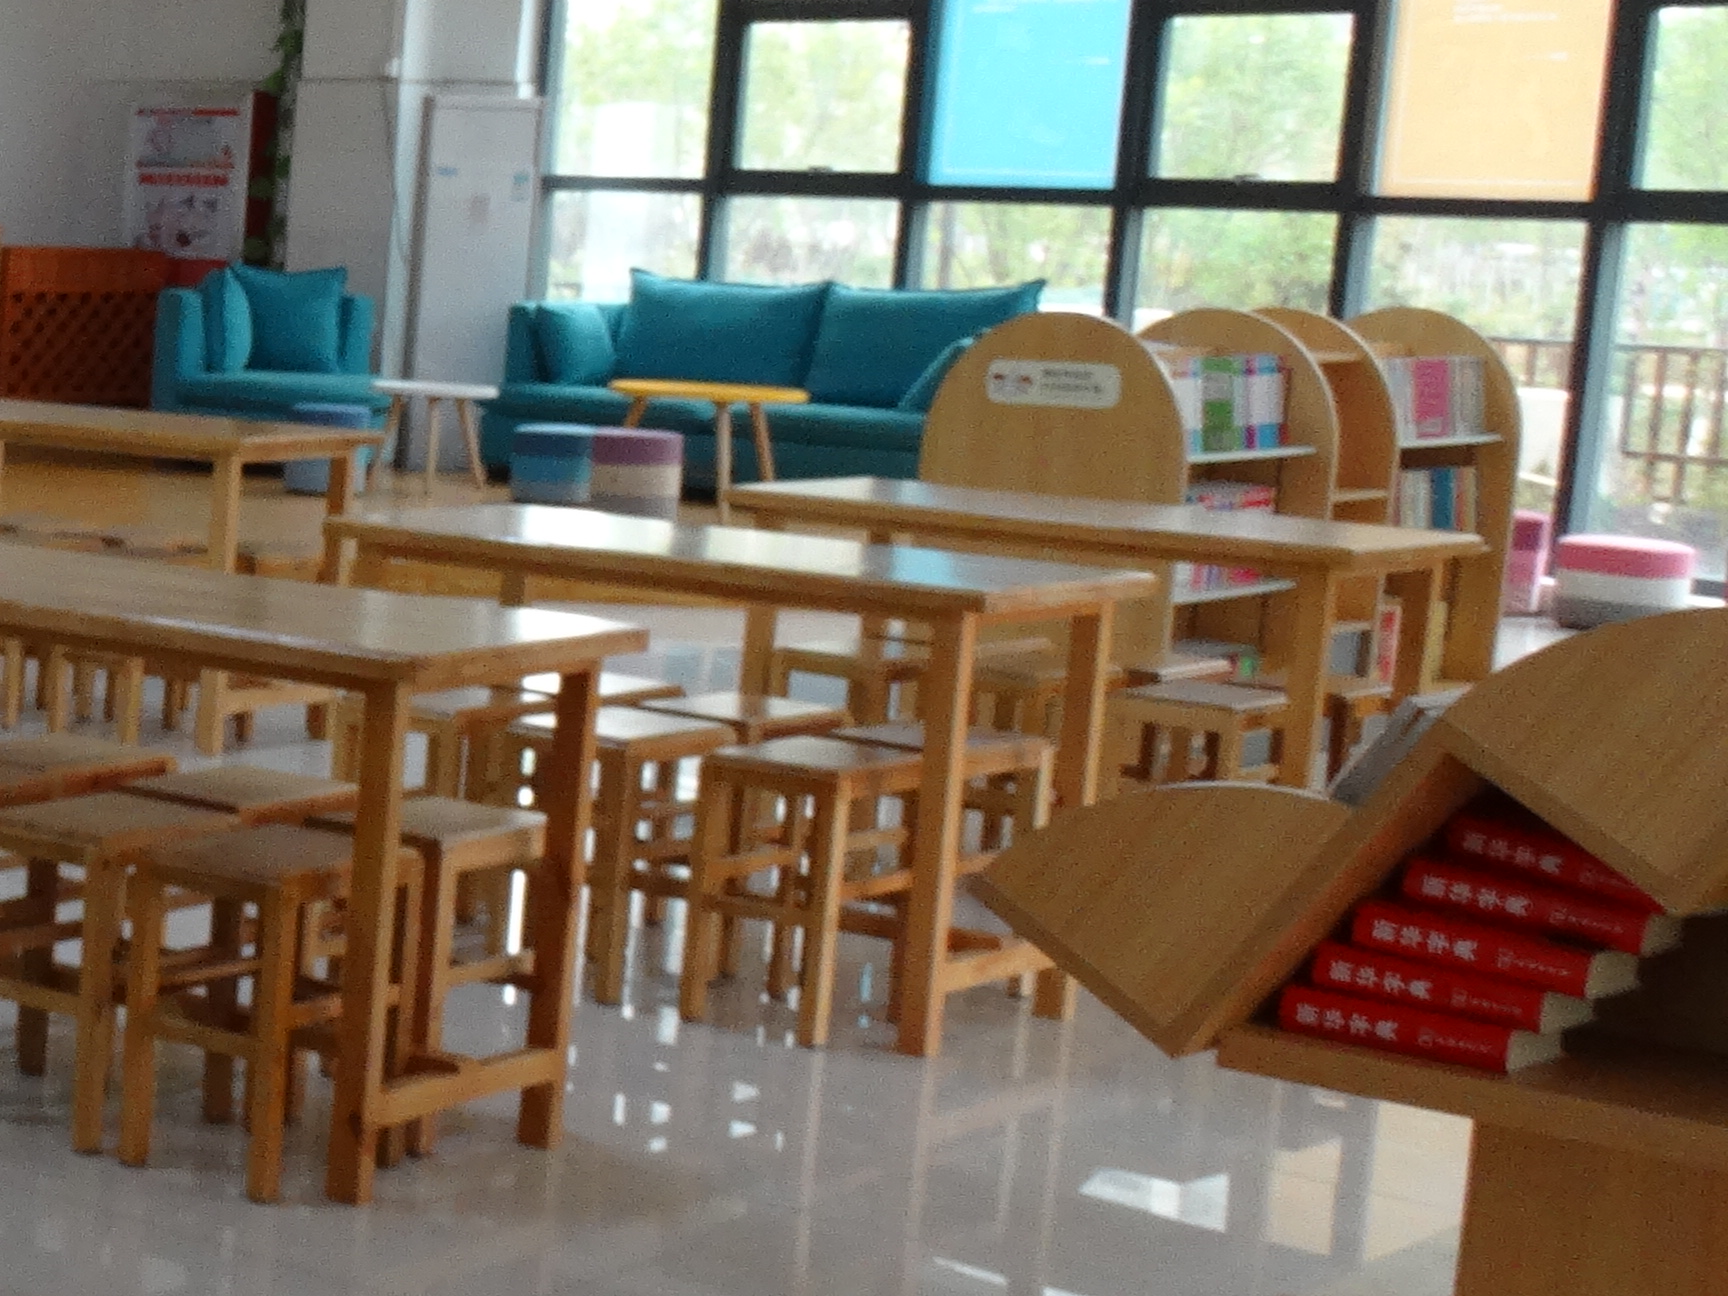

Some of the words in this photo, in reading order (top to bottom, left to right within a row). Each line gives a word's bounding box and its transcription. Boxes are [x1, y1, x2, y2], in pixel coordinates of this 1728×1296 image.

[1420, 873, 1530, 916] 新华字典
[1371, 918, 1479, 961] 新华字典
[1329, 959, 1433, 1001] 新华字典
[1295, 1002, 1399, 1041] 新华字典
